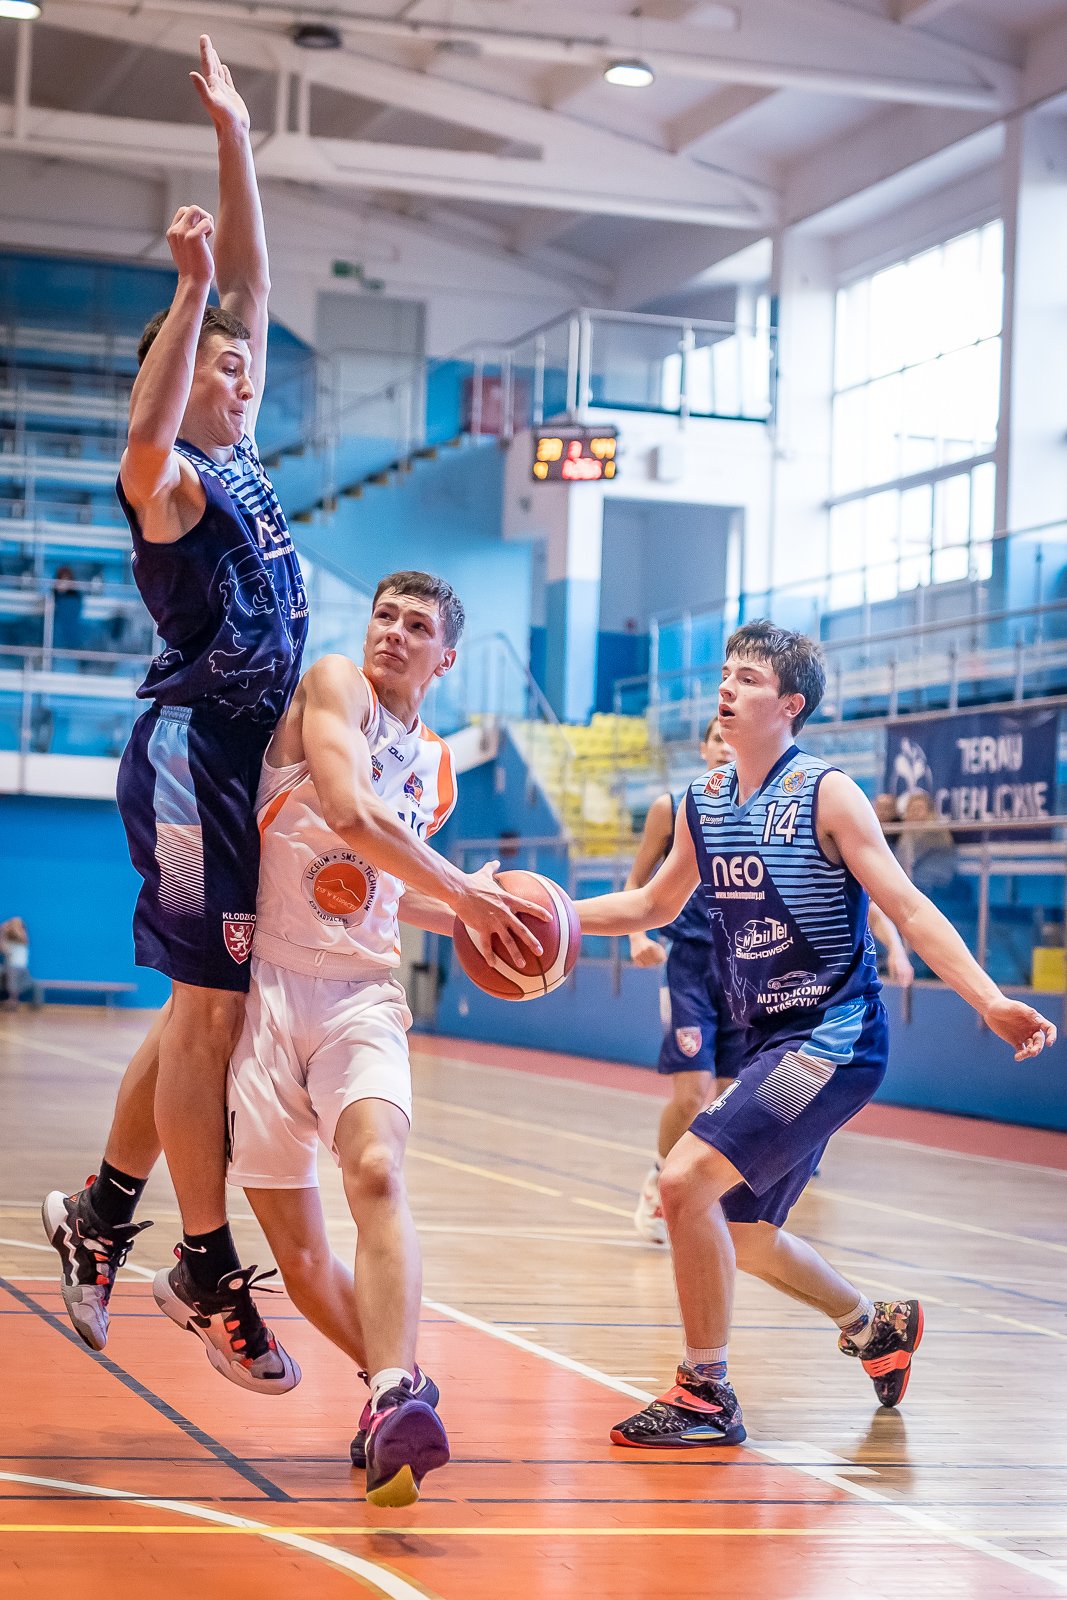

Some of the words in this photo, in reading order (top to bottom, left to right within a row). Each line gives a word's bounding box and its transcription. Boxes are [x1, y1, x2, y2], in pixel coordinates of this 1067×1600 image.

[763, 801, 800, 844] 14
[306, 856, 330, 880] LICEUM
[341, 852, 357, 862] SMS
[364, 865, 377, 912] TECHNIKUM
